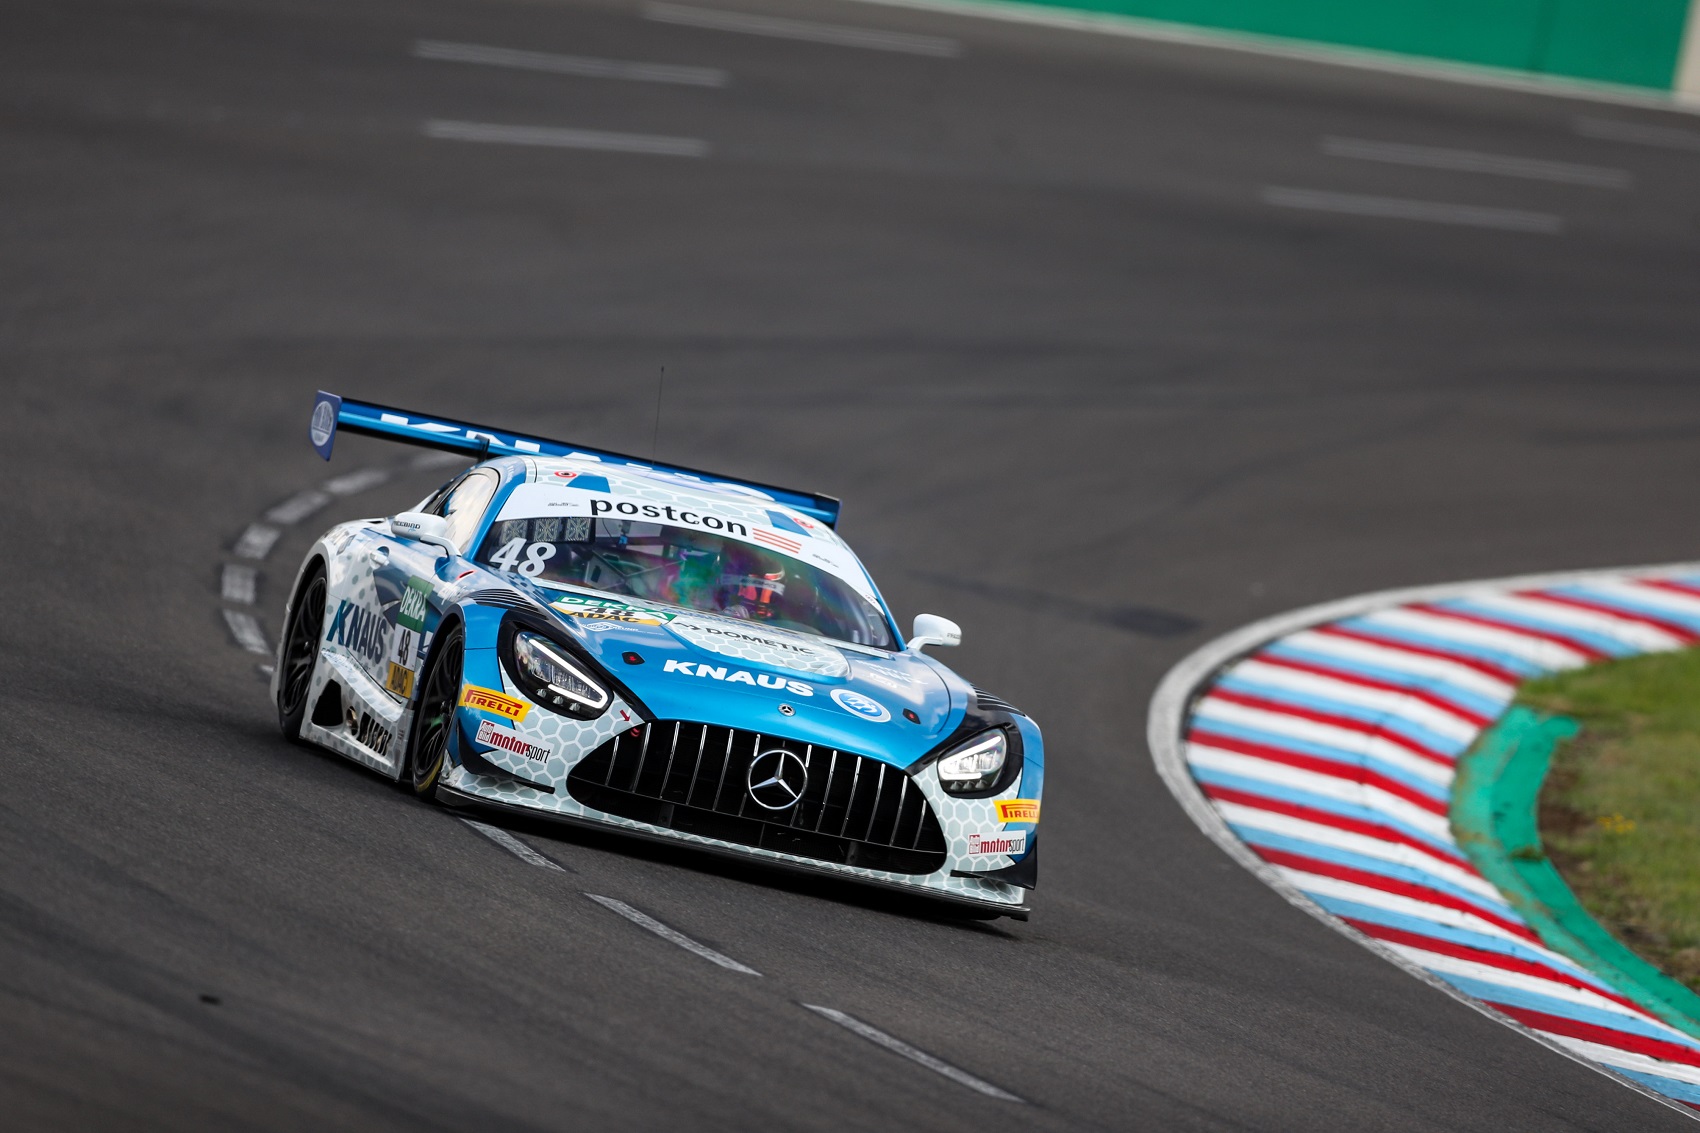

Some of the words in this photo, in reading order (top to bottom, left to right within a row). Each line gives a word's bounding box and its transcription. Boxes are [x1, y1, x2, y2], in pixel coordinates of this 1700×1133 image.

[590, 499, 748, 537] postcon
[489, 537, 557, 577] 48
[399, 586, 428, 622] DEKRA
[561, 596, 670, 621] DEKRA
[568, 611, 641, 624] ADAC
[326, 599, 388, 665] KNAUS
[397, 628, 412, 667] 48
[705, 626, 816, 655] DOMETIC
[663, 659, 814, 697] KNAUS
[464, 688, 524, 717] PIRELLI
[489, 731, 551, 764] motorsport
[980, 836, 1025, 854] motorsport
